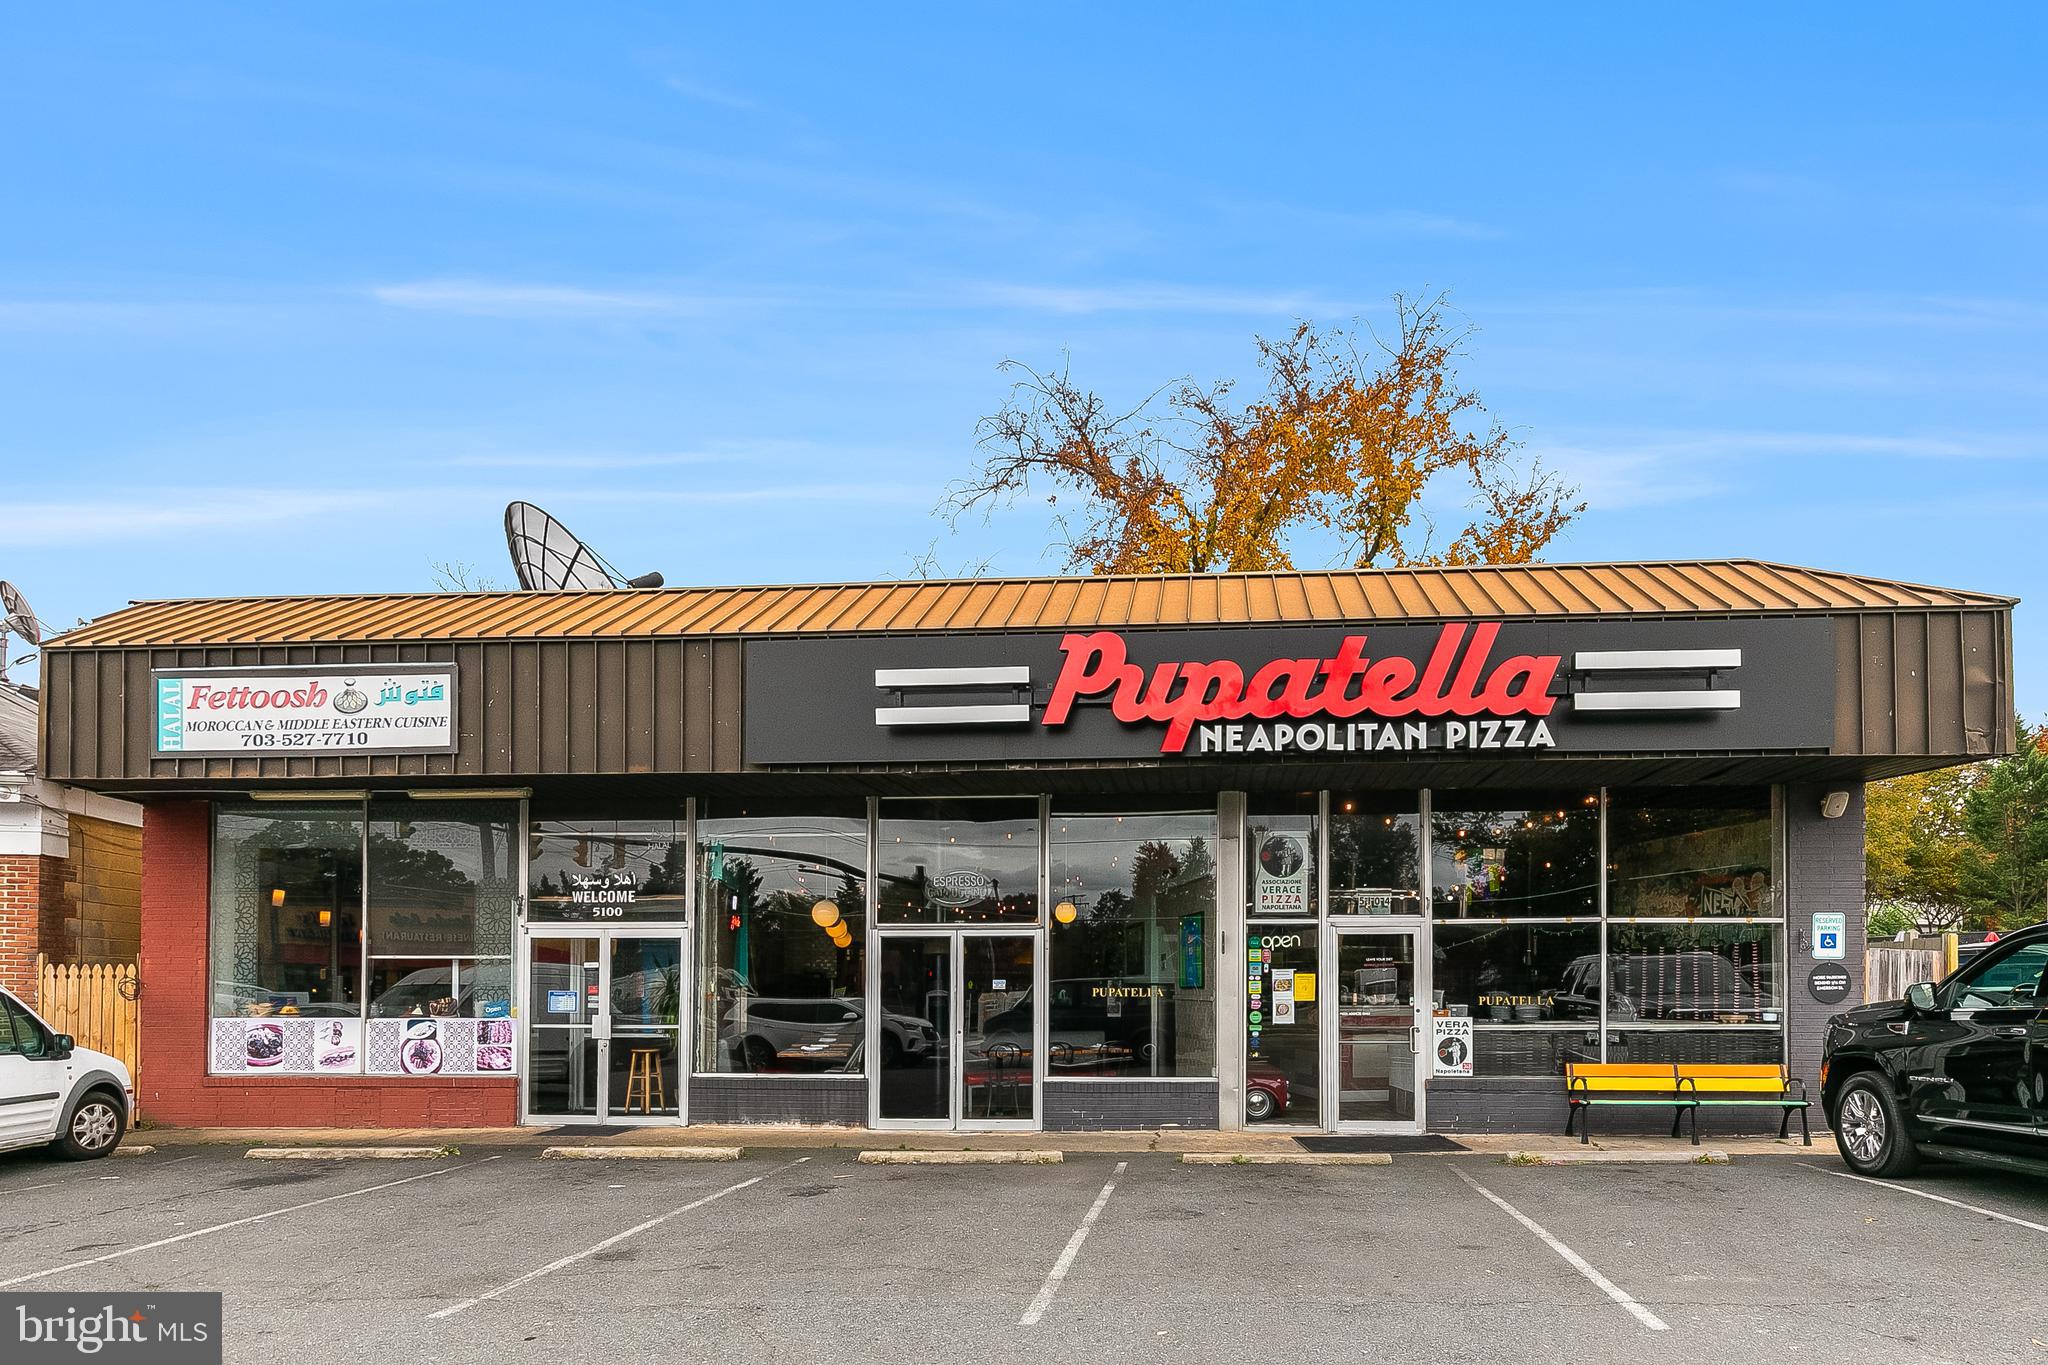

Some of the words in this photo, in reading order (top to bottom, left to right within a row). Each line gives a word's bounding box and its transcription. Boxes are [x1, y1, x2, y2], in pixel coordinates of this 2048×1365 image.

[373, 678, 444, 707] فتوش
[1041, 622, 1562, 752] Pupatella
[187, 681, 328, 710] Fettoosh
[162, 681, 181, 750] HALAL
[185, 720, 263, 732] MOROCCAN
[264, 721, 275, 731] &
[277, 719, 330, 731] MIDDLE
[332, 717, 393, 730] EASTERN
[394, 716, 449, 729] CUISINE
[241, 731, 369, 747] 703-527-7710
[1200, 721, 1427, 753] NEAPOLITAN
[1446, 719, 1556, 749] PIZZA
[933, 875, 984, 887] ESPRESSO
[572, 890, 636, 903] WELCOME
[1262, 886, 1302, 894] VERACE
[1262, 895, 1302, 904] PIZZA
[592, 907, 623, 917] 5100
[1261, 934, 1301, 951] open
[1478, 995, 1554, 1006] PUPATELLA
[1909, 1075, 1954, 1083] DENALI
